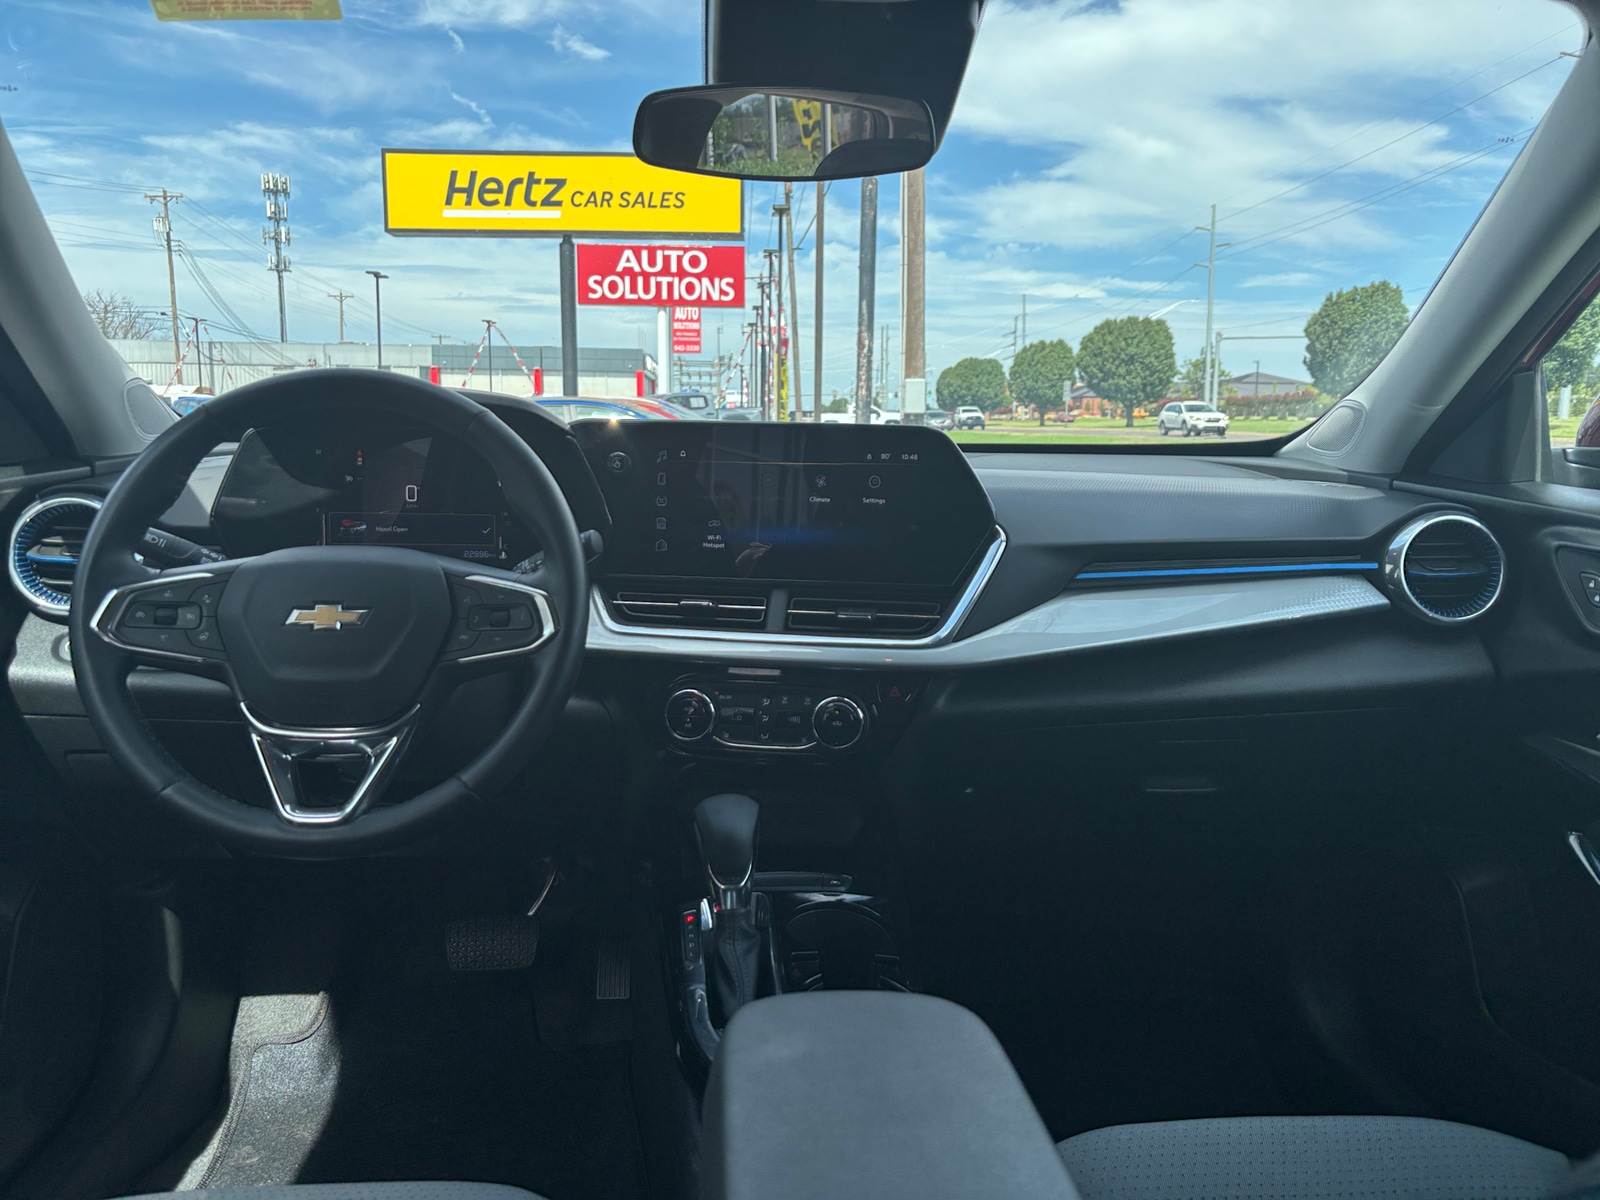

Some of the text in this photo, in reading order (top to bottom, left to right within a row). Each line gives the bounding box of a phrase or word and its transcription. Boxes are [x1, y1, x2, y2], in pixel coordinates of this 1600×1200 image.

[444, 169, 686, 210] Hertz CAR SALES
[615, 249, 708, 274] AUTO
[587, 274, 736, 301] SOLUTIONS
[674, 306, 699, 320] AUTO
[405, 484, 418, 502] 0
[862, 496, 887, 505] Settings
[392, 525, 409, 533] Open
[702, 541, 725, 549] Hotspot
